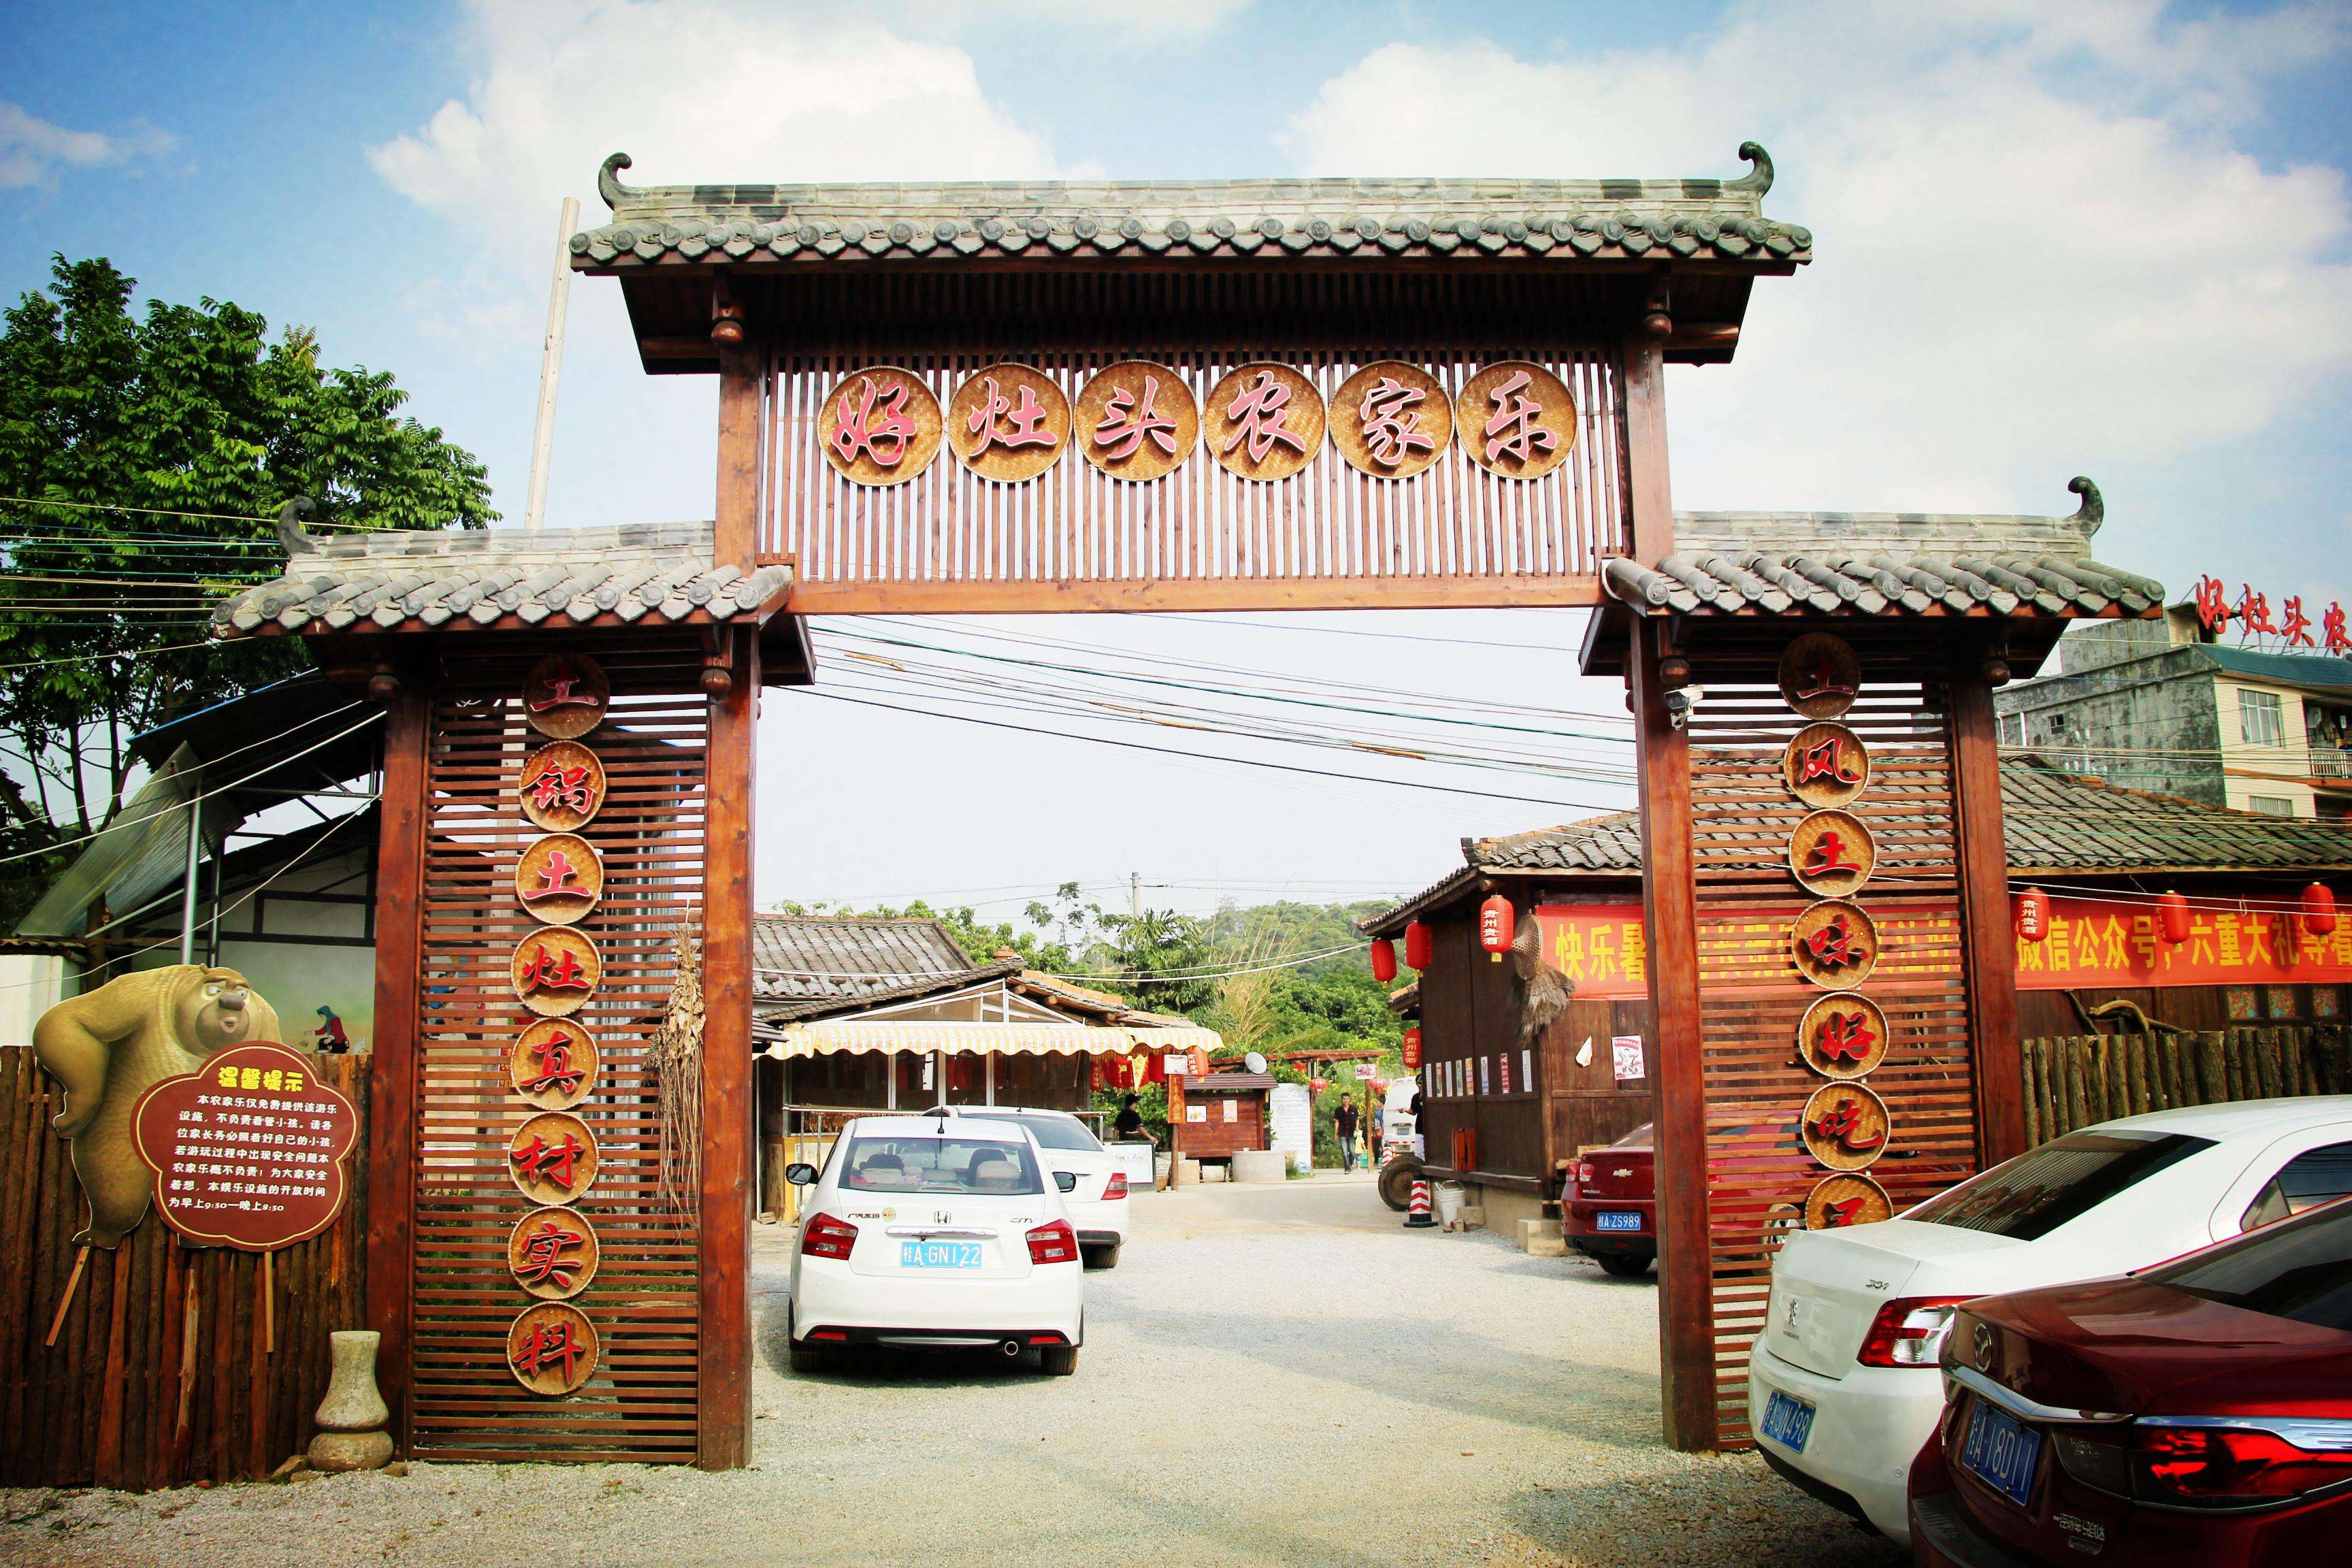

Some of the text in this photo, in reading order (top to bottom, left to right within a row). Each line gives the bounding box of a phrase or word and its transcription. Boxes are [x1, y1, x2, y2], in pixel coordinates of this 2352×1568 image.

[831, 370, 1560, 468] 好灶头农家乐
[1483, 909, 1499, 945] 贵州贵酒
[2022, 900, 2038, 934] 贵州贵酒
[512, 662, 598, 1383] 土锅土灶真材实料
[218, 1066, 304, 1092] 温馨提示
[197, 1094, 337, 1114] 本农家乐仅免费提供该游乐
[174, 1145, 330, 1164] 若游玩过程中出现安全问题本
